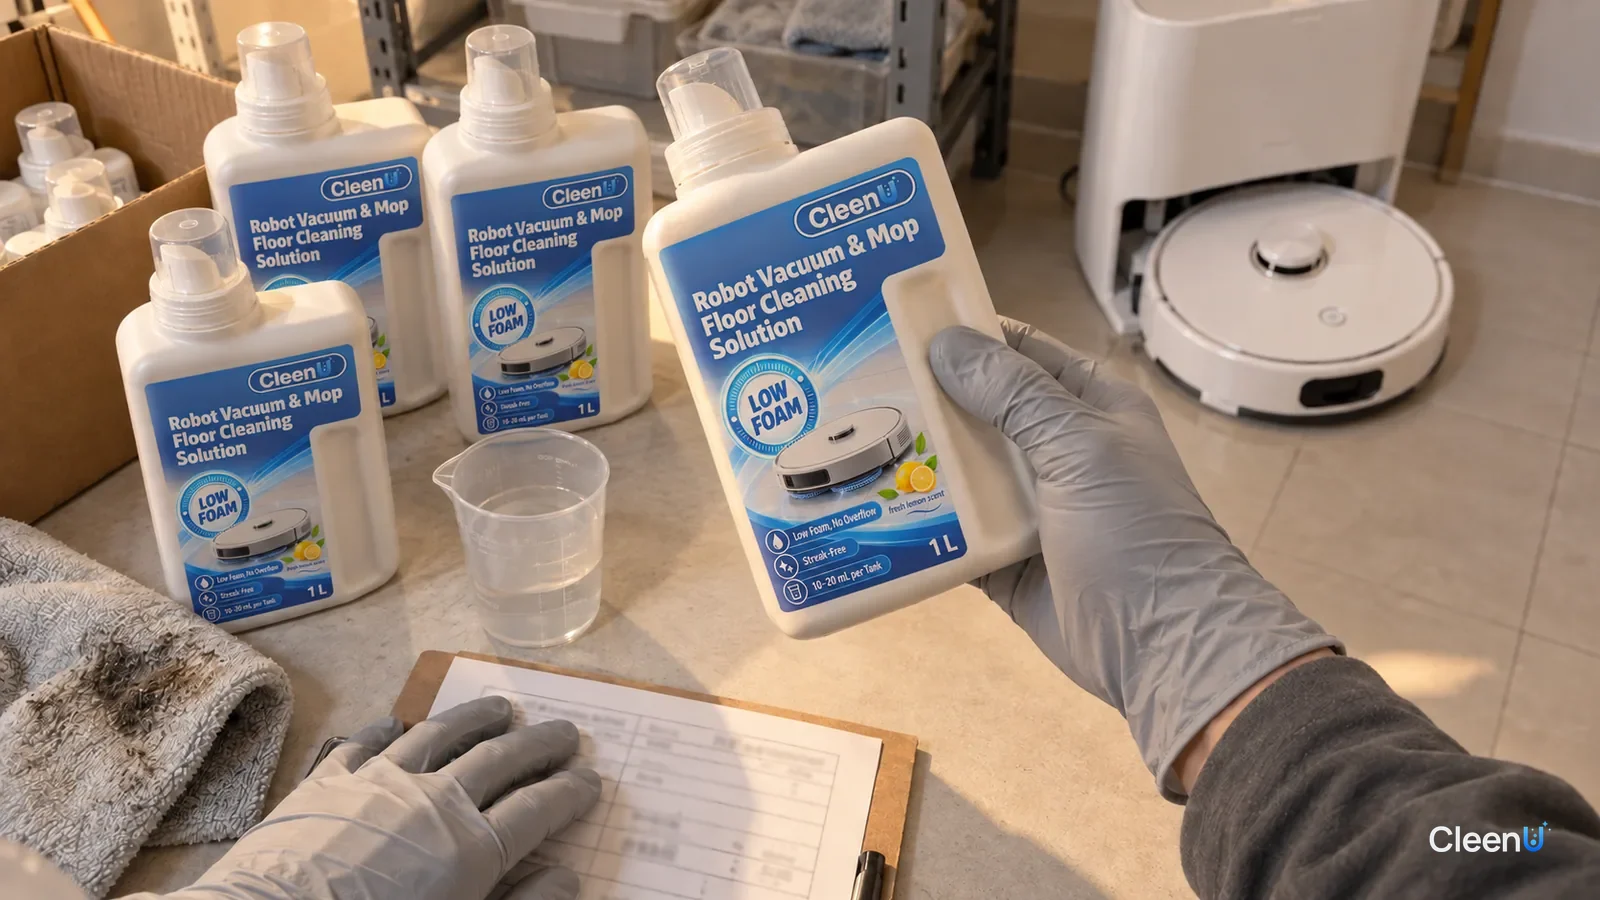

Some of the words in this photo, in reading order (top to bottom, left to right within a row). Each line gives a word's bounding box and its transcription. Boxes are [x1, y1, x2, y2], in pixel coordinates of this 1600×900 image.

[331, 169, 399, 197] CleenU
[552, 177, 617, 205] CleenU
[809, 176, 899, 229] CleenU
[249, 215, 296, 234] Robot
[296, 206, 358, 228] Vacuum
[360, 203, 372, 218] &
[374, 199, 409, 216] Mop
[468, 224, 513, 243] Robot
[514, 215, 573, 236] Vacuum
[576, 210, 588, 226] &
[590, 206, 623, 223] Mop
[252, 234, 293, 251] Floor
[296, 224, 363, 245] Cleaning
[470, 243, 510, 261] Floor
[512, 232, 578, 254] Cleaning
[256, 248, 321, 269] Solution
[472, 257, 536, 278] Solution
[691, 274, 758, 313] Robot
[758, 245, 845, 289] Vacuum
[848, 234, 867, 257] &
[866, 217, 920, 250] Mop
[489, 302, 517, 323] LOW
[700, 302, 757, 337] Floor
[759, 268, 857, 315] Cleaning
[488, 315, 524, 338] FOAM
[709, 314, 803, 360] Solution
[259, 357, 332, 389] CleenU
[168, 410, 219, 431] Robot
[219, 399, 286, 422] Vacuum
[288, 393, 302, 409] &
[304, 387, 343, 406] Mop
[382, 392, 390, 403] L
[578, 404, 584, 415] 1
[587, 402, 595, 413] L
[748, 379, 788, 413] LOW
[751, 396, 803, 436] FOAM
[172, 429, 216, 448] Floor
[219, 415, 293, 440] Cleaning
[176, 442, 247, 466] Solution
[198, 488, 228, 510] LOW
[198, 500, 237, 525] FOAM
[906, 497, 927, 509] lemon
[927, 490, 945, 502] scent
[793, 529, 809, 541] Low
[809, 522, 833, 537] Foam,
[831, 517, 844, 528] No
[843, 506, 877, 524] Overflow
[802, 545, 847, 566] Streak-Free
[929, 537, 942, 556] 1
[944, 534, 958, 553] L
[837, 571, 850, 584] mL
[851, 569, 864, 581] per
[864, 561, 883, 575] Tank
[307, 586, 315, 597] 1
[318, 584, 327, 595] L
